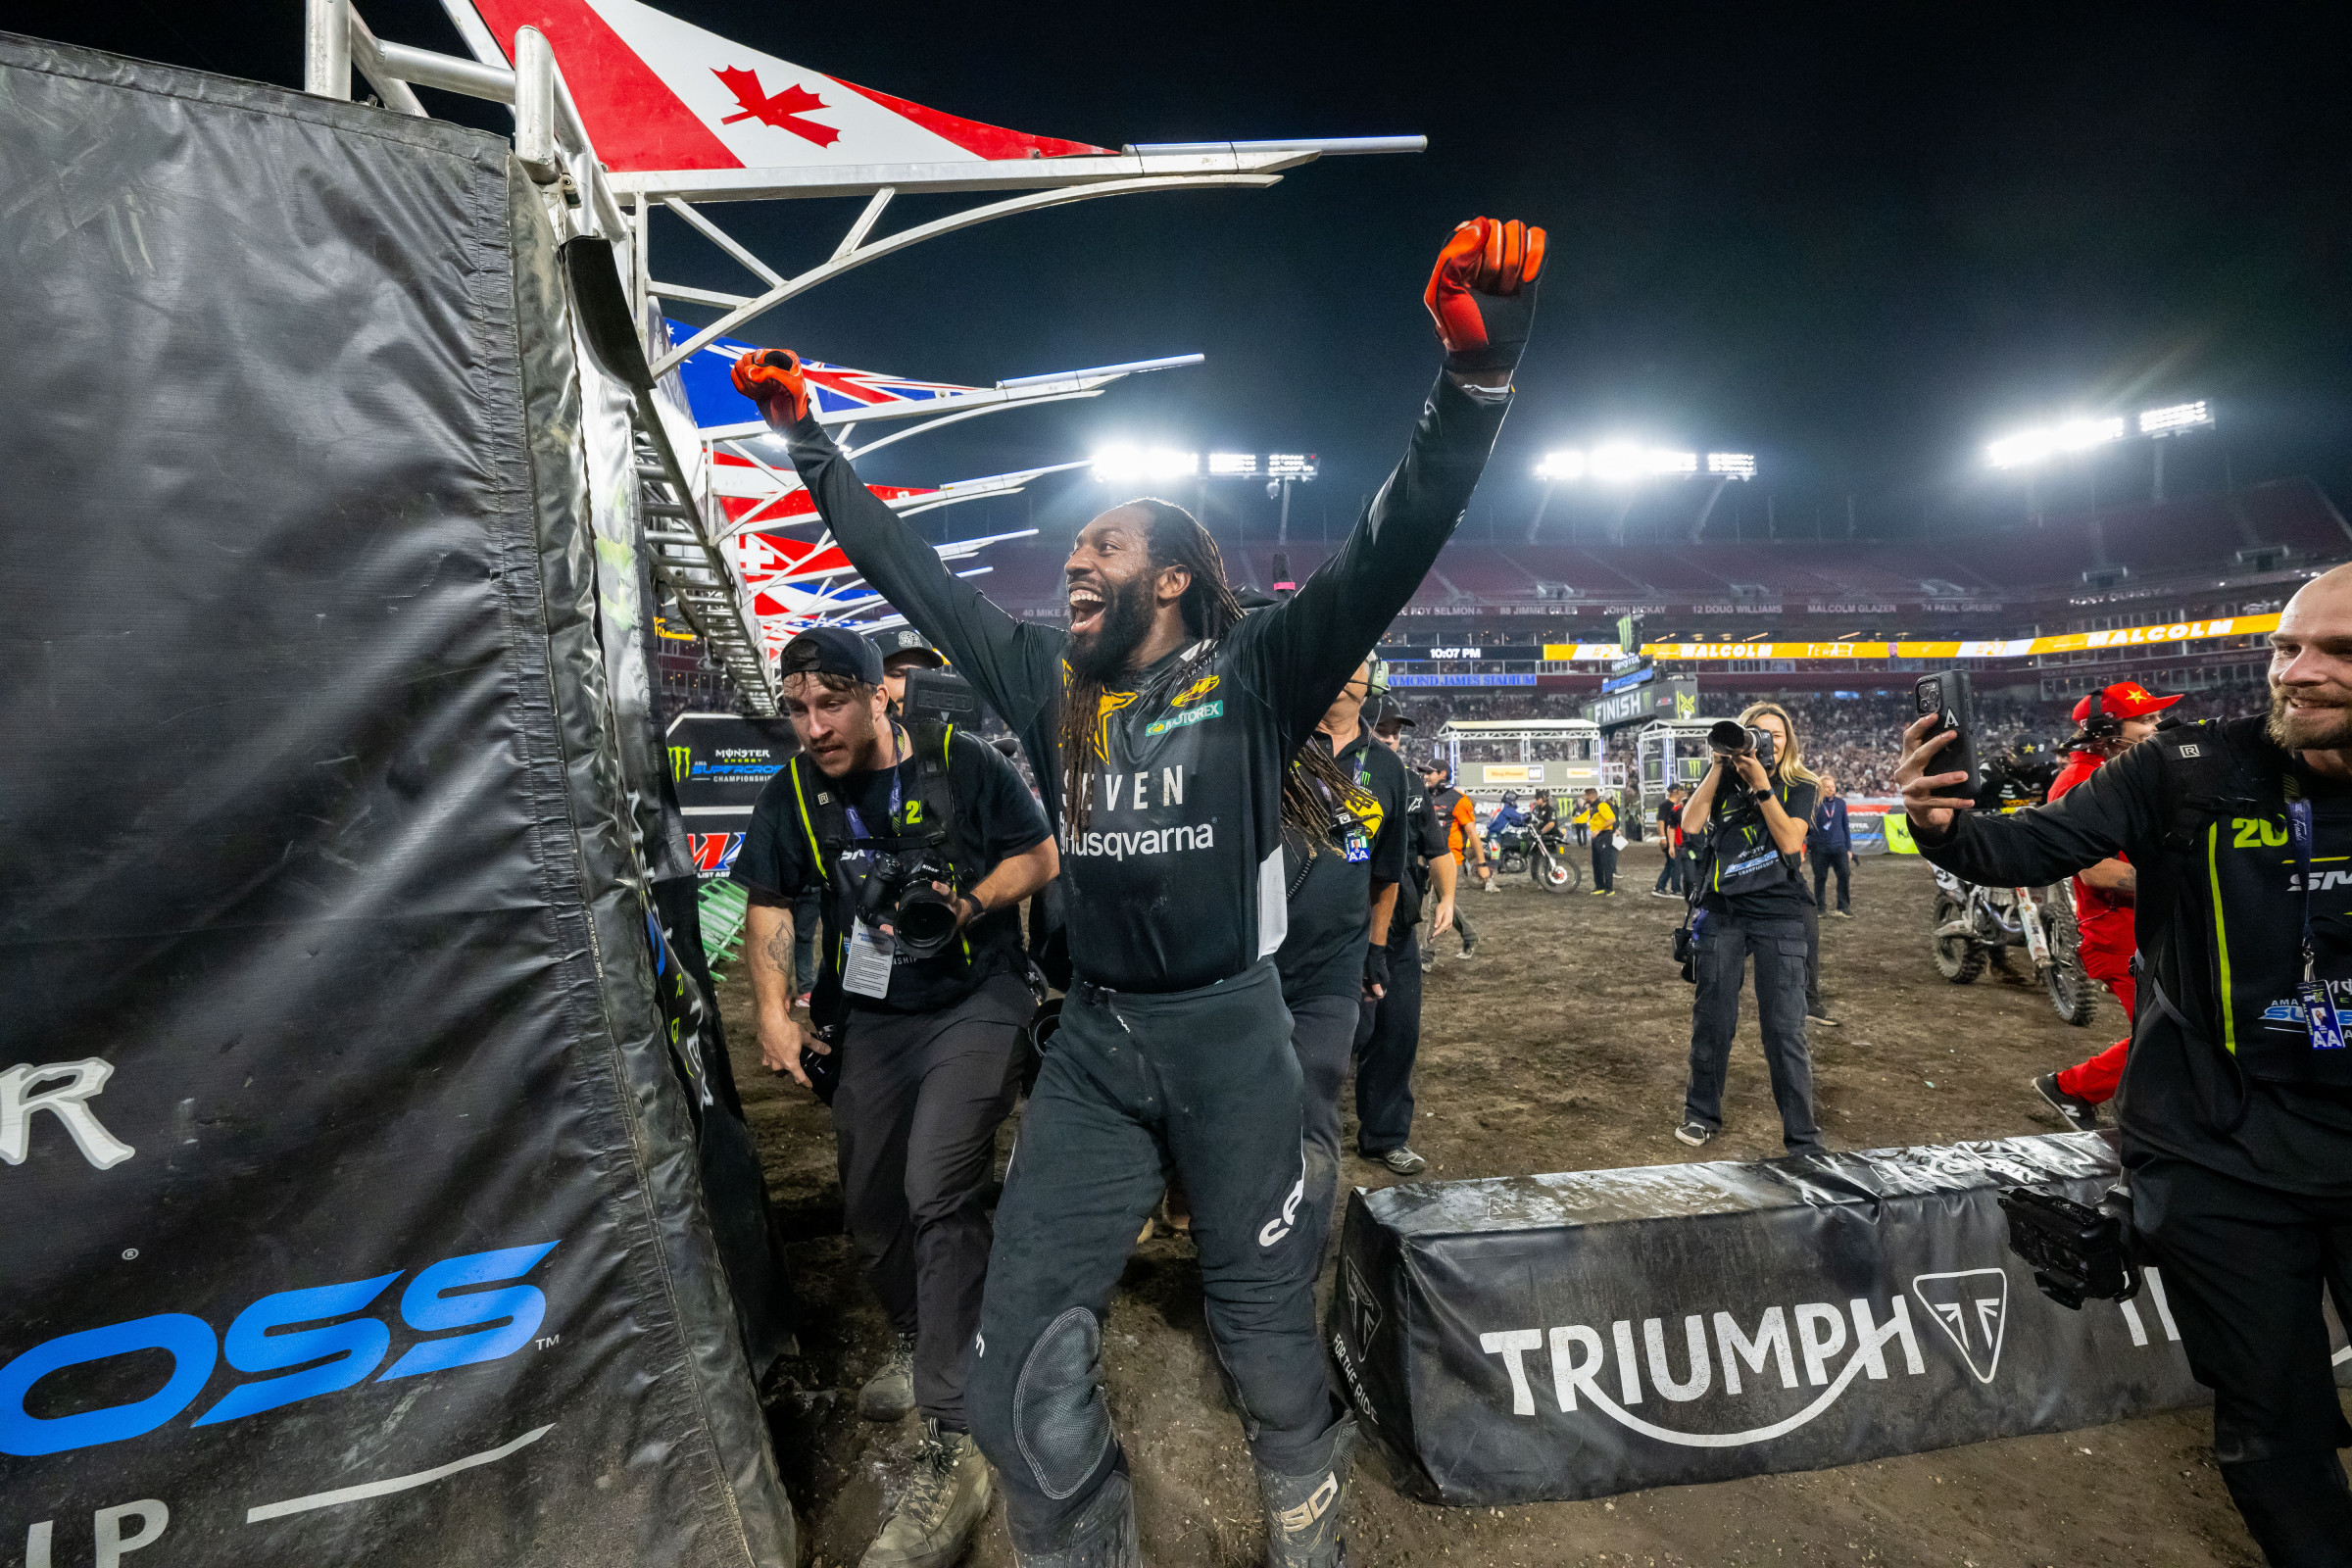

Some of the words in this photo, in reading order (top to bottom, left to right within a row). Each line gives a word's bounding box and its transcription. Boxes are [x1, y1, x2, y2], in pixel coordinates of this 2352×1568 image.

[1022, 609, 1034, 617] 40
[1036, 609, 1061, 617] MIKE
[1410, 607, 1432, 615] ROY
[1434, 607, 1474, 615] SELMON
[1603, 606, 1630, 614] JOHN
[1692, 605, 1703, 613] 12
[1705, 605, 1734, 613] DOUG
[1736, 605, 1783, 613] WILLIAMS
[1807, 604, 1855, 612] MALCOLM
[1858, 604, 1896, 612] GLAZER
[2086, 619, 2233, 648] MALCOLM
[1430, 648, 1460, 659] 10:07
[1462, 648, 1481, 659] PM
[1680, 644, 1773, 658] MALCOLM
[1388, 674, 1439, 686] AYMOND
[1441, 674, 1480, 686] JAMES
[1484, 673, 1536, 686] STADIUM
[1593, 691, 1642, 724] FINISH
[1164, 703, 1219, 731] MOTOREX
[715, 749, 770, 759] MONSTER
[691, 764, 786, 774] SUPERCRO
[1065, 823, 1214, 861] Husqvarna
[1348, 850, 1369, 862] AA
[921, 863, 940, 873] Nikon
[2313, 1030, 2343, 1049] AA
[1479, 1295, 1926, 1447] TRIUMPH
[1333, 1333, 1347, 1360] FOR
[1343, 1354, 1357, 1390] THE
[1354, 1383, 1380, 1426] RIDE
